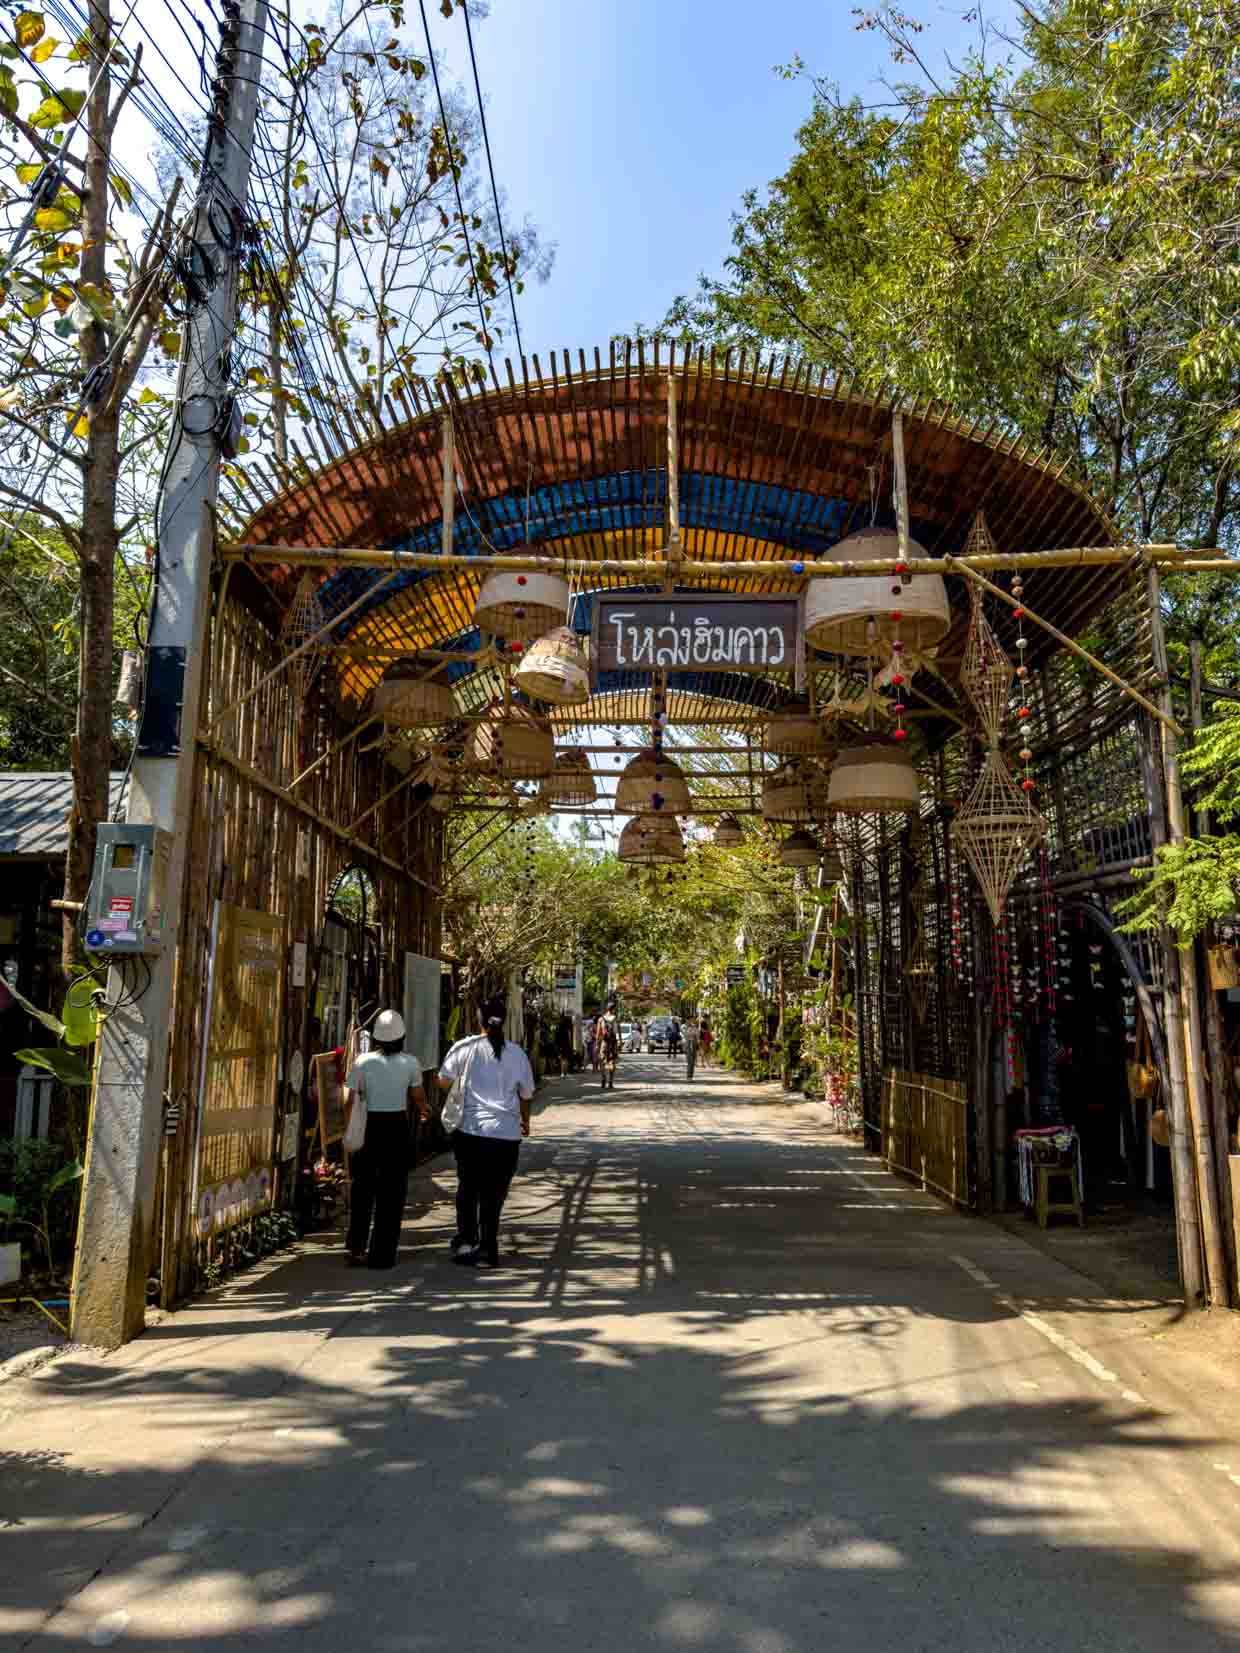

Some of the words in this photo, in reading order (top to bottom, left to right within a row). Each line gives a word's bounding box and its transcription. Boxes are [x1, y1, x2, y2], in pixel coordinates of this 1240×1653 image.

[609, 610, 785, 666] โหล่งฮิมคาว
